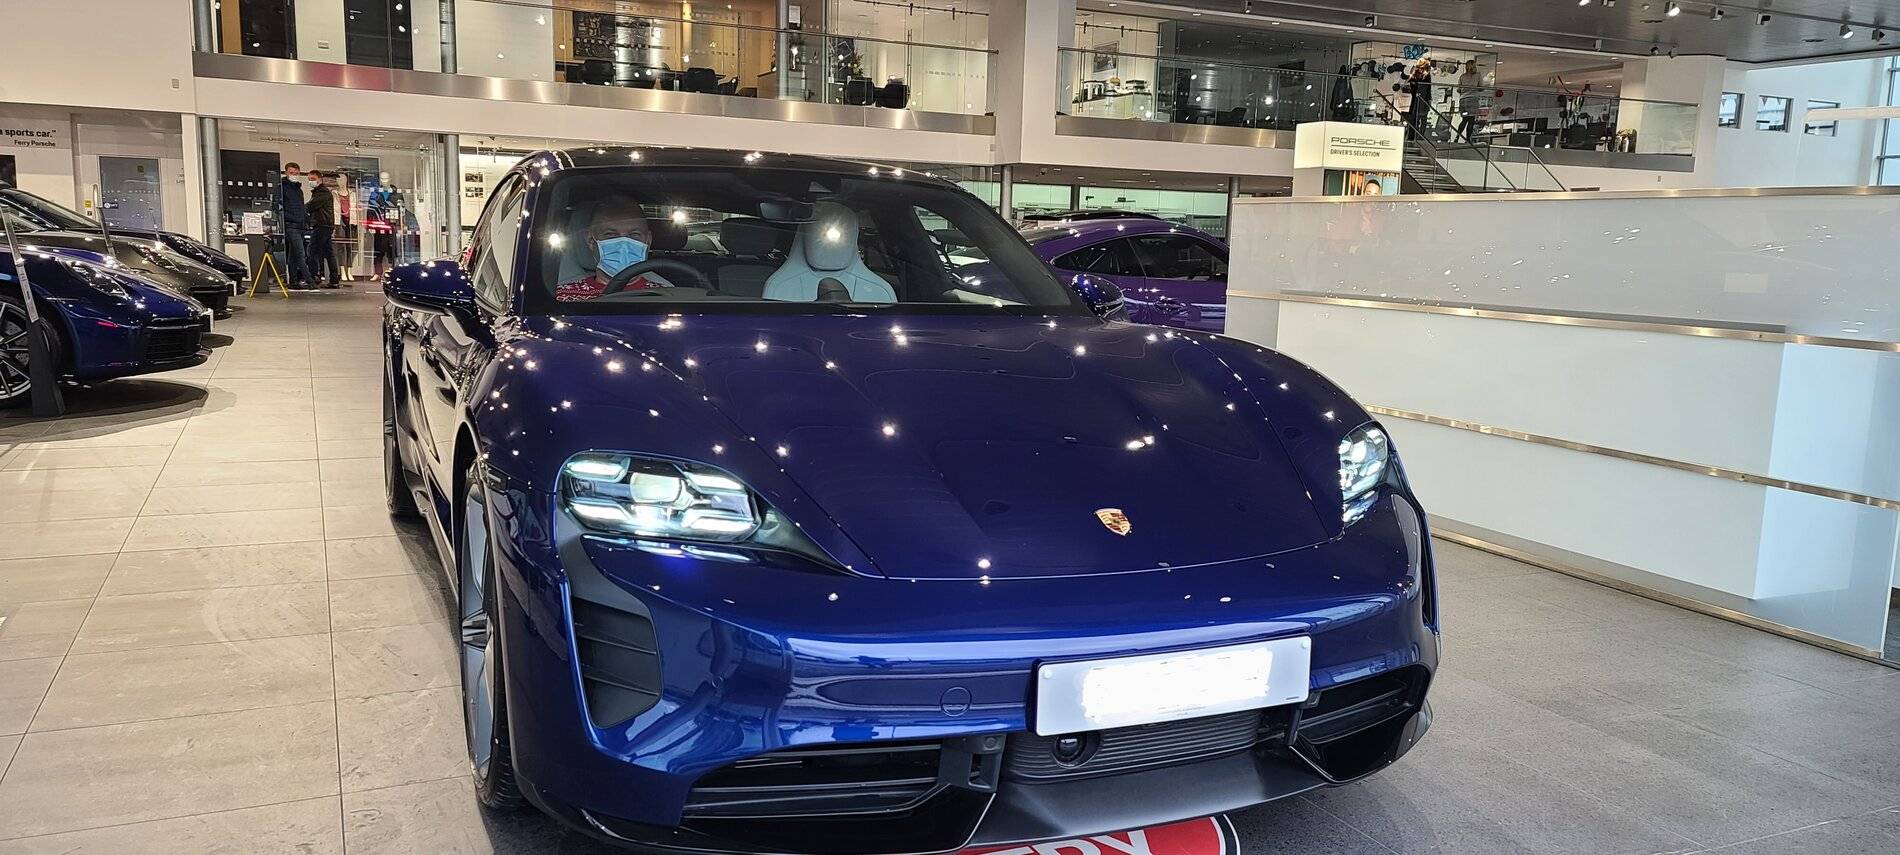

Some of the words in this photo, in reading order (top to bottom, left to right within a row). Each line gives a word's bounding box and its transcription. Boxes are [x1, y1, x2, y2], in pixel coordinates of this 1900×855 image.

[5, 129, 35, 138] sports
[14, 139, 30, 147] Ferry
[1331, 136, 1391, 147] PORSCHE
